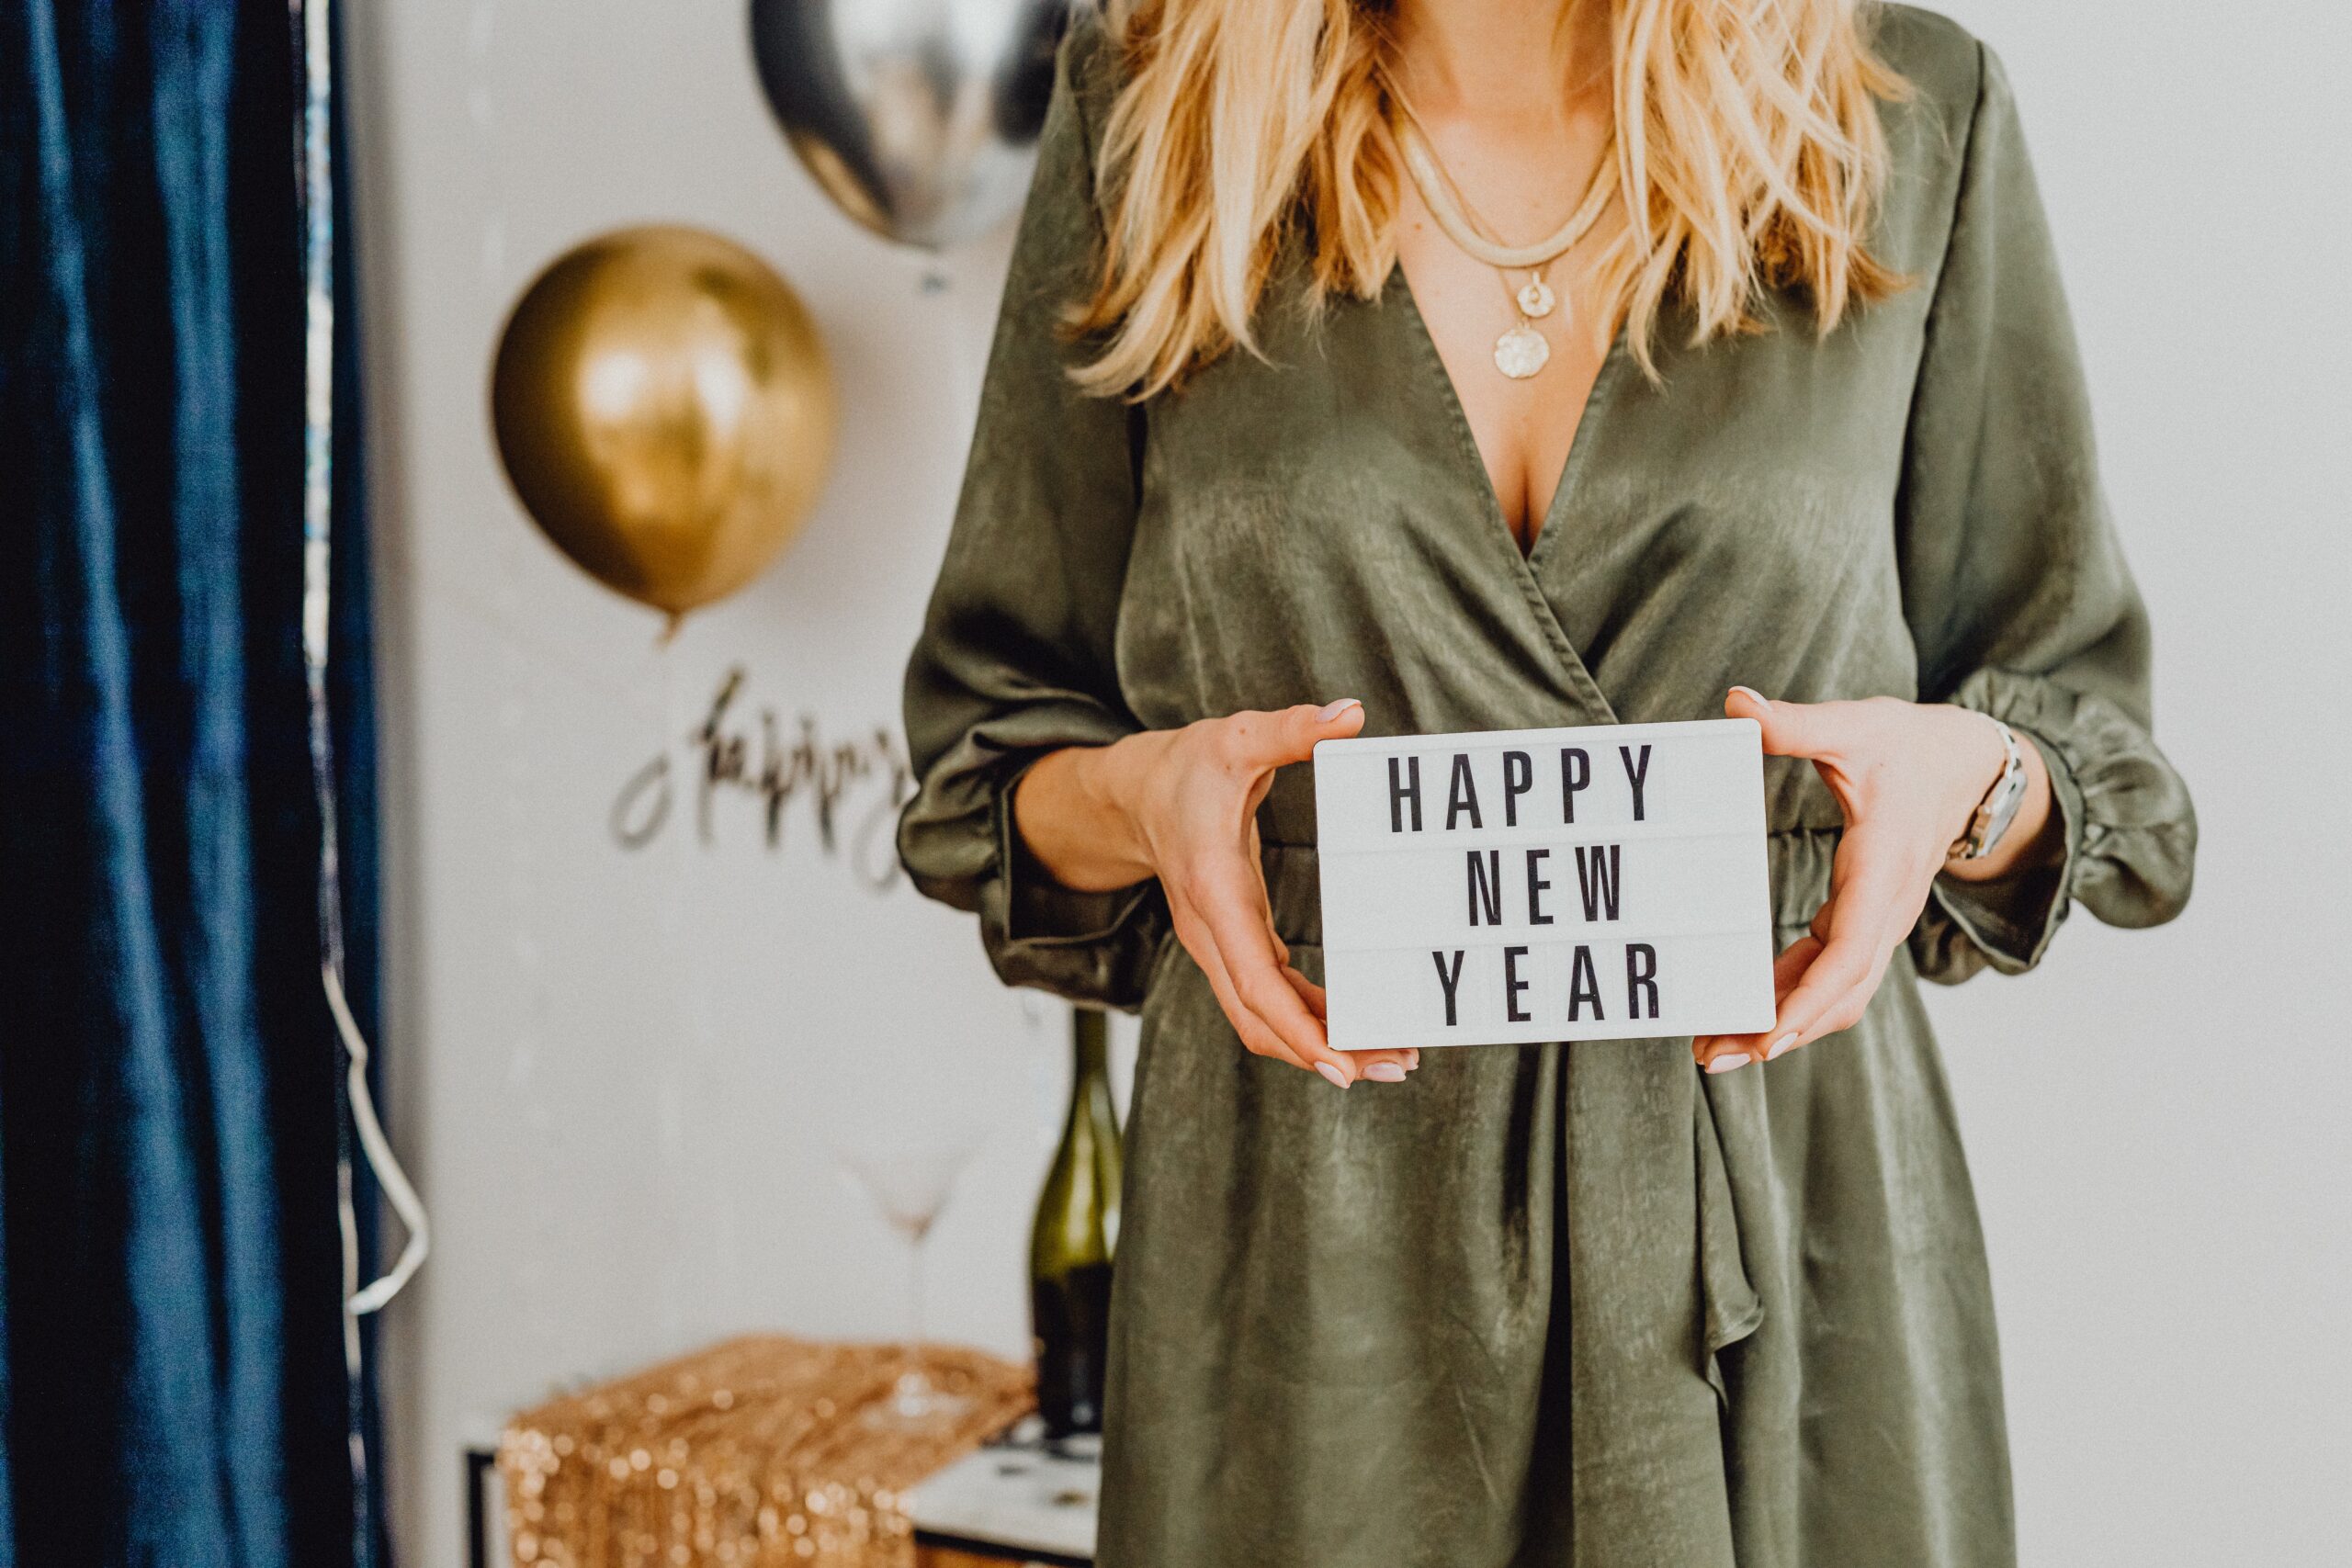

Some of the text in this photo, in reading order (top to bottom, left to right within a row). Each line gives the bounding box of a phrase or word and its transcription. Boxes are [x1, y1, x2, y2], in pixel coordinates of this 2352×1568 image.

[1388, 745, 1651, 832] HAPPY
[1467, 845, 1620, 926] NEW
[1432, 943, 1658, 1026] YEAR
